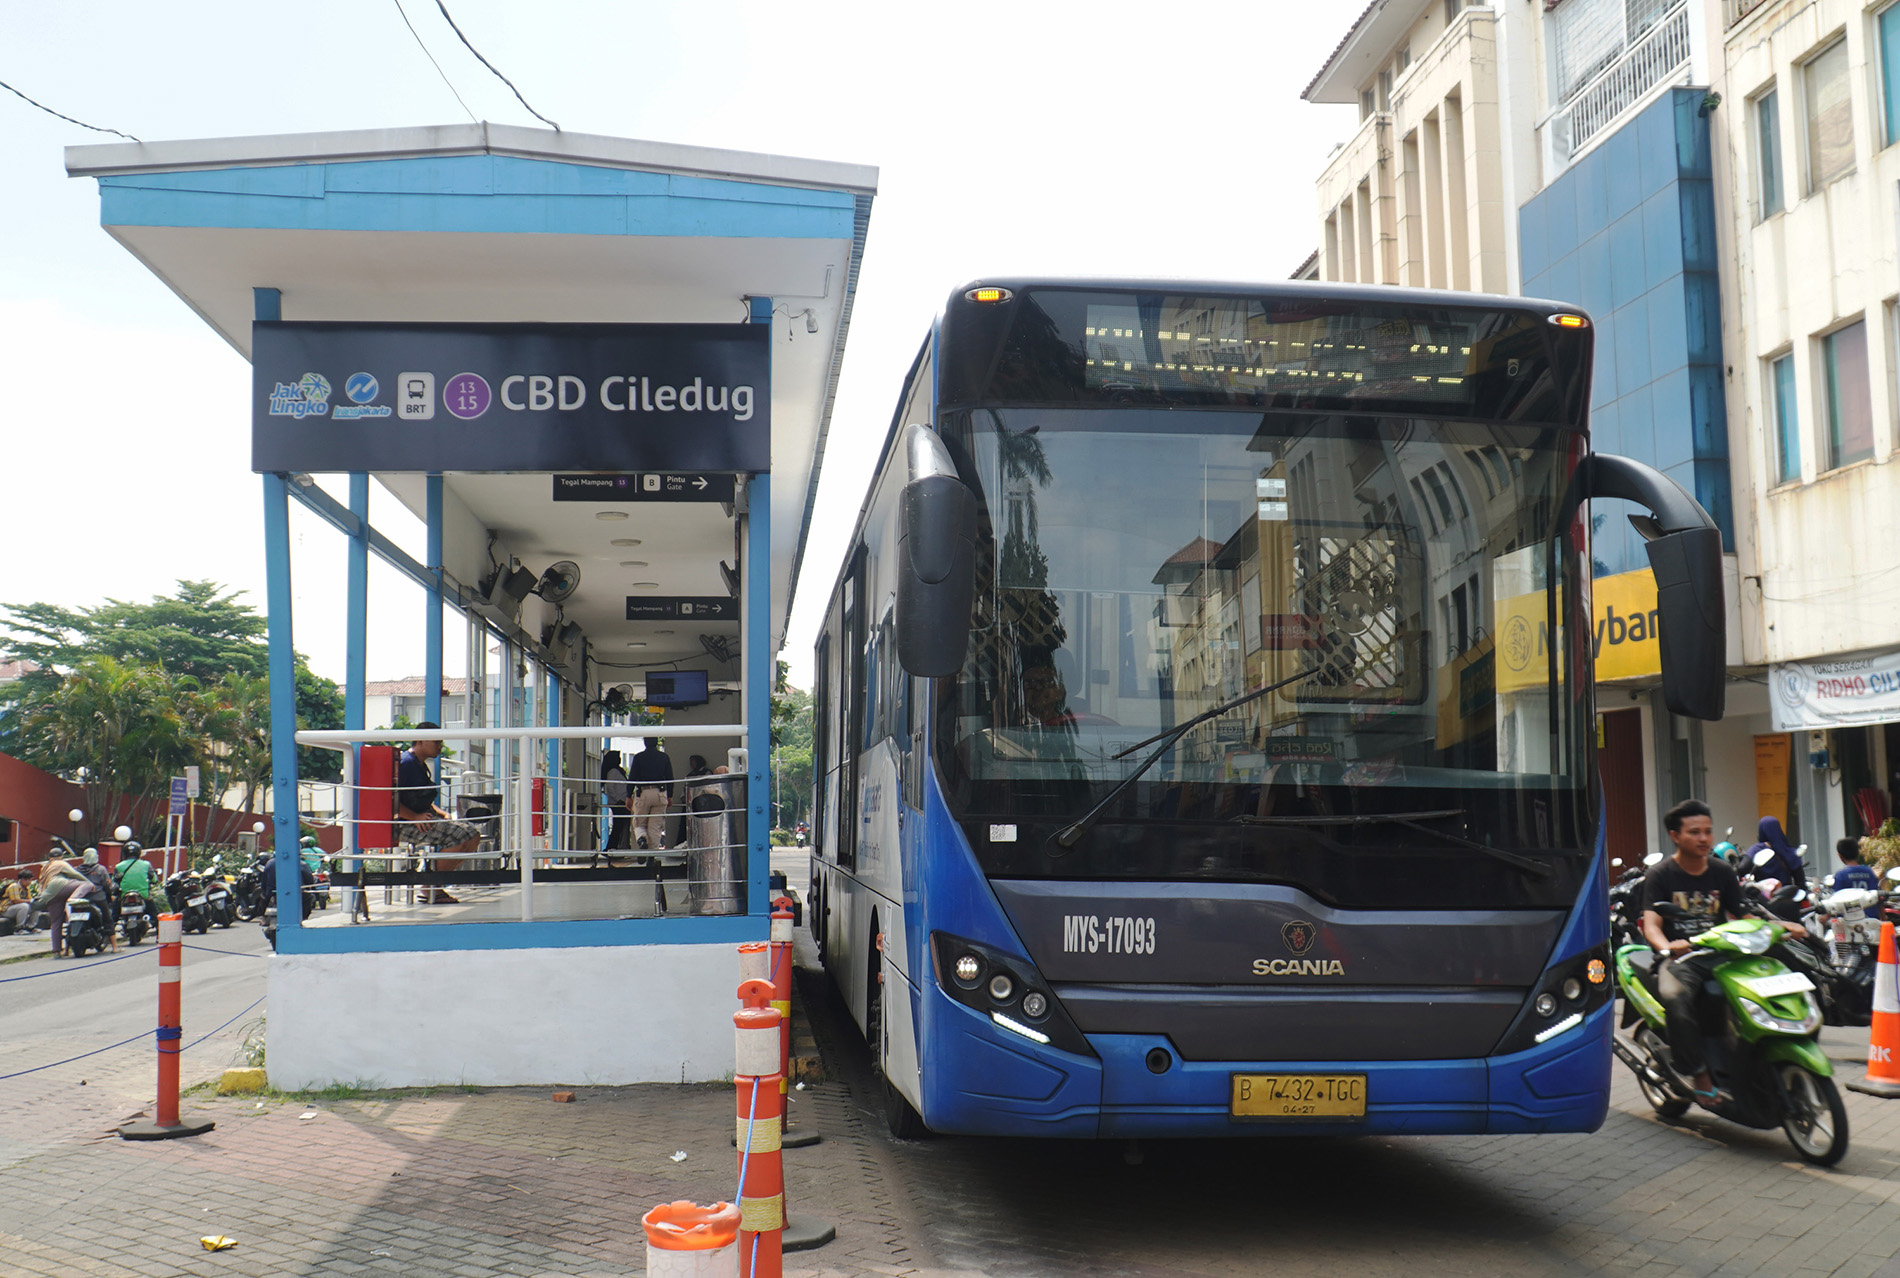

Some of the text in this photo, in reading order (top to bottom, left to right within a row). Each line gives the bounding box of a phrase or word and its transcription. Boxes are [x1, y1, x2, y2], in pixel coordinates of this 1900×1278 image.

[271, 383, 301, 399] Jak
[459, 382, 475, 393] 13
[457, 396, 478, 410] 15
[500, 375, 754, 420] CBD Ciledug
[271, 399, 328, 418] Lingko
[406, 404, 426, 413] BRT
[561, 478, 580, 486] Tegal
[581, 479, 613, 487] Mampang
[1812, 665, 1832, 675] TOKO
[1817, 676, 1866, 698] RIDHO
[1870, 671, 1900, 693] CIL
[1064, 915, 1155, 954] MYS-17093
[1252, 959, 1345, 975] SCANIA
[1240, 1079, 1360, 1101] B 7432 TGC
